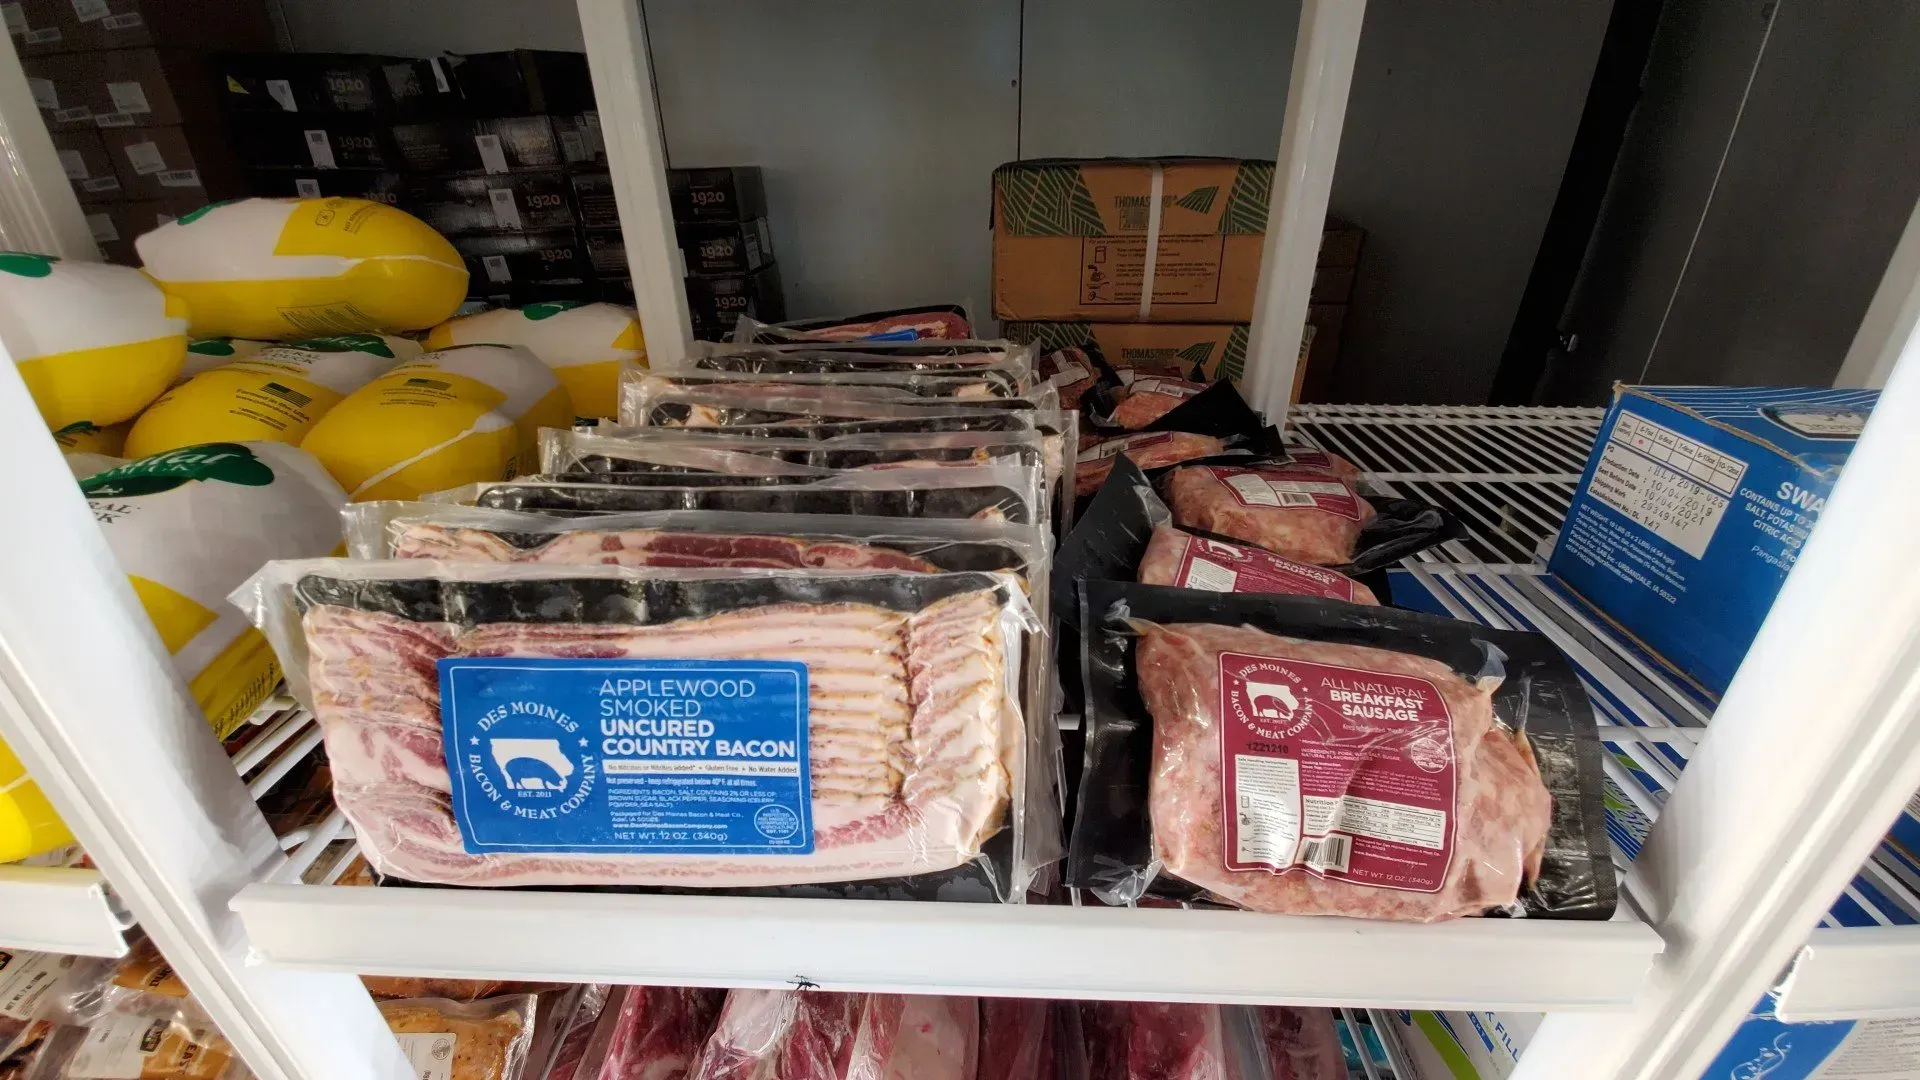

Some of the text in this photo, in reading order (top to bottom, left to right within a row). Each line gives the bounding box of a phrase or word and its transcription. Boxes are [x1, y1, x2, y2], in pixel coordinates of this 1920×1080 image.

[525, 194, 561, 209] 1920
[691, 192, 725, 206] 1920
[540, 249, 572, 263] 1920
[700, 246, 734, 260] 1920
[715, 295, 747, 310] 1920
[1601, 455, 1629, 473] Production
[1627, 469, 1640, 479] Date
[1592, 476, 1614, 493] Shipping
[1597, 465, 1609, 476] Best
[1608, 472, 1625, 484] Before
[1623, 480, 1637, 491] Date
[1579, 503, 1590, 512] NET
[1588, 486, 1623, 509] Establishment
[1642, 516, 1661, 532] 147
[1739, 486, 1780, 513] CONTAINS
[1778, 505, 1793, 519] UP
[1744, 501, 1768, 519] SALT,
[1569, 529, 1588, 543] Packed
[1751, 518, 1781, 539] CITRIC
[1239, 663, 1302, 684] DES MOINES
[599, 679, 756, 698] APPLEWOOD
[1320, 677, 1348, 692] ALL
[600, 699, 701, 717] SMOKED
[1330, 689, 1425, 711] BREAKFAST
[478, 701, 580, 734] DES MOINES
[1231, 690, 1313, 740] BACON & MEAT COMPANY
[1341, 705, 1420, 722] SAUSAGE
[600, 719, 715, 738] UNCURED
[602, 738, 795, 758] COUNTRY BACON
[704, 763, 725, 772] Gluten
[726, 764, 739, 772] Free
[748, 765, 758, 773] No
[758, 765, 777, 774] Water
[777, 765, 797, 774] Added
[469, 754, 596, 820] BACON & MEAT COMPANY
[517, 791, 536, 799] EST.
[695, 789, 730, 798] CONTAINS
[1305, 798, 1334, 807] Nutrition
[688, 811, 709, 819] Bacon
[614, 832, 637, 841] NET
[639, 832, 659, 841] WT.
[659, 830, 671, 841] 12
[692, 831, 729, 843] (340g)
[1352, 868, 1369, 877] NET
[1408, 876, 1433, 886] (340g)
[1495, 1021, 1519, 1063] FILL
